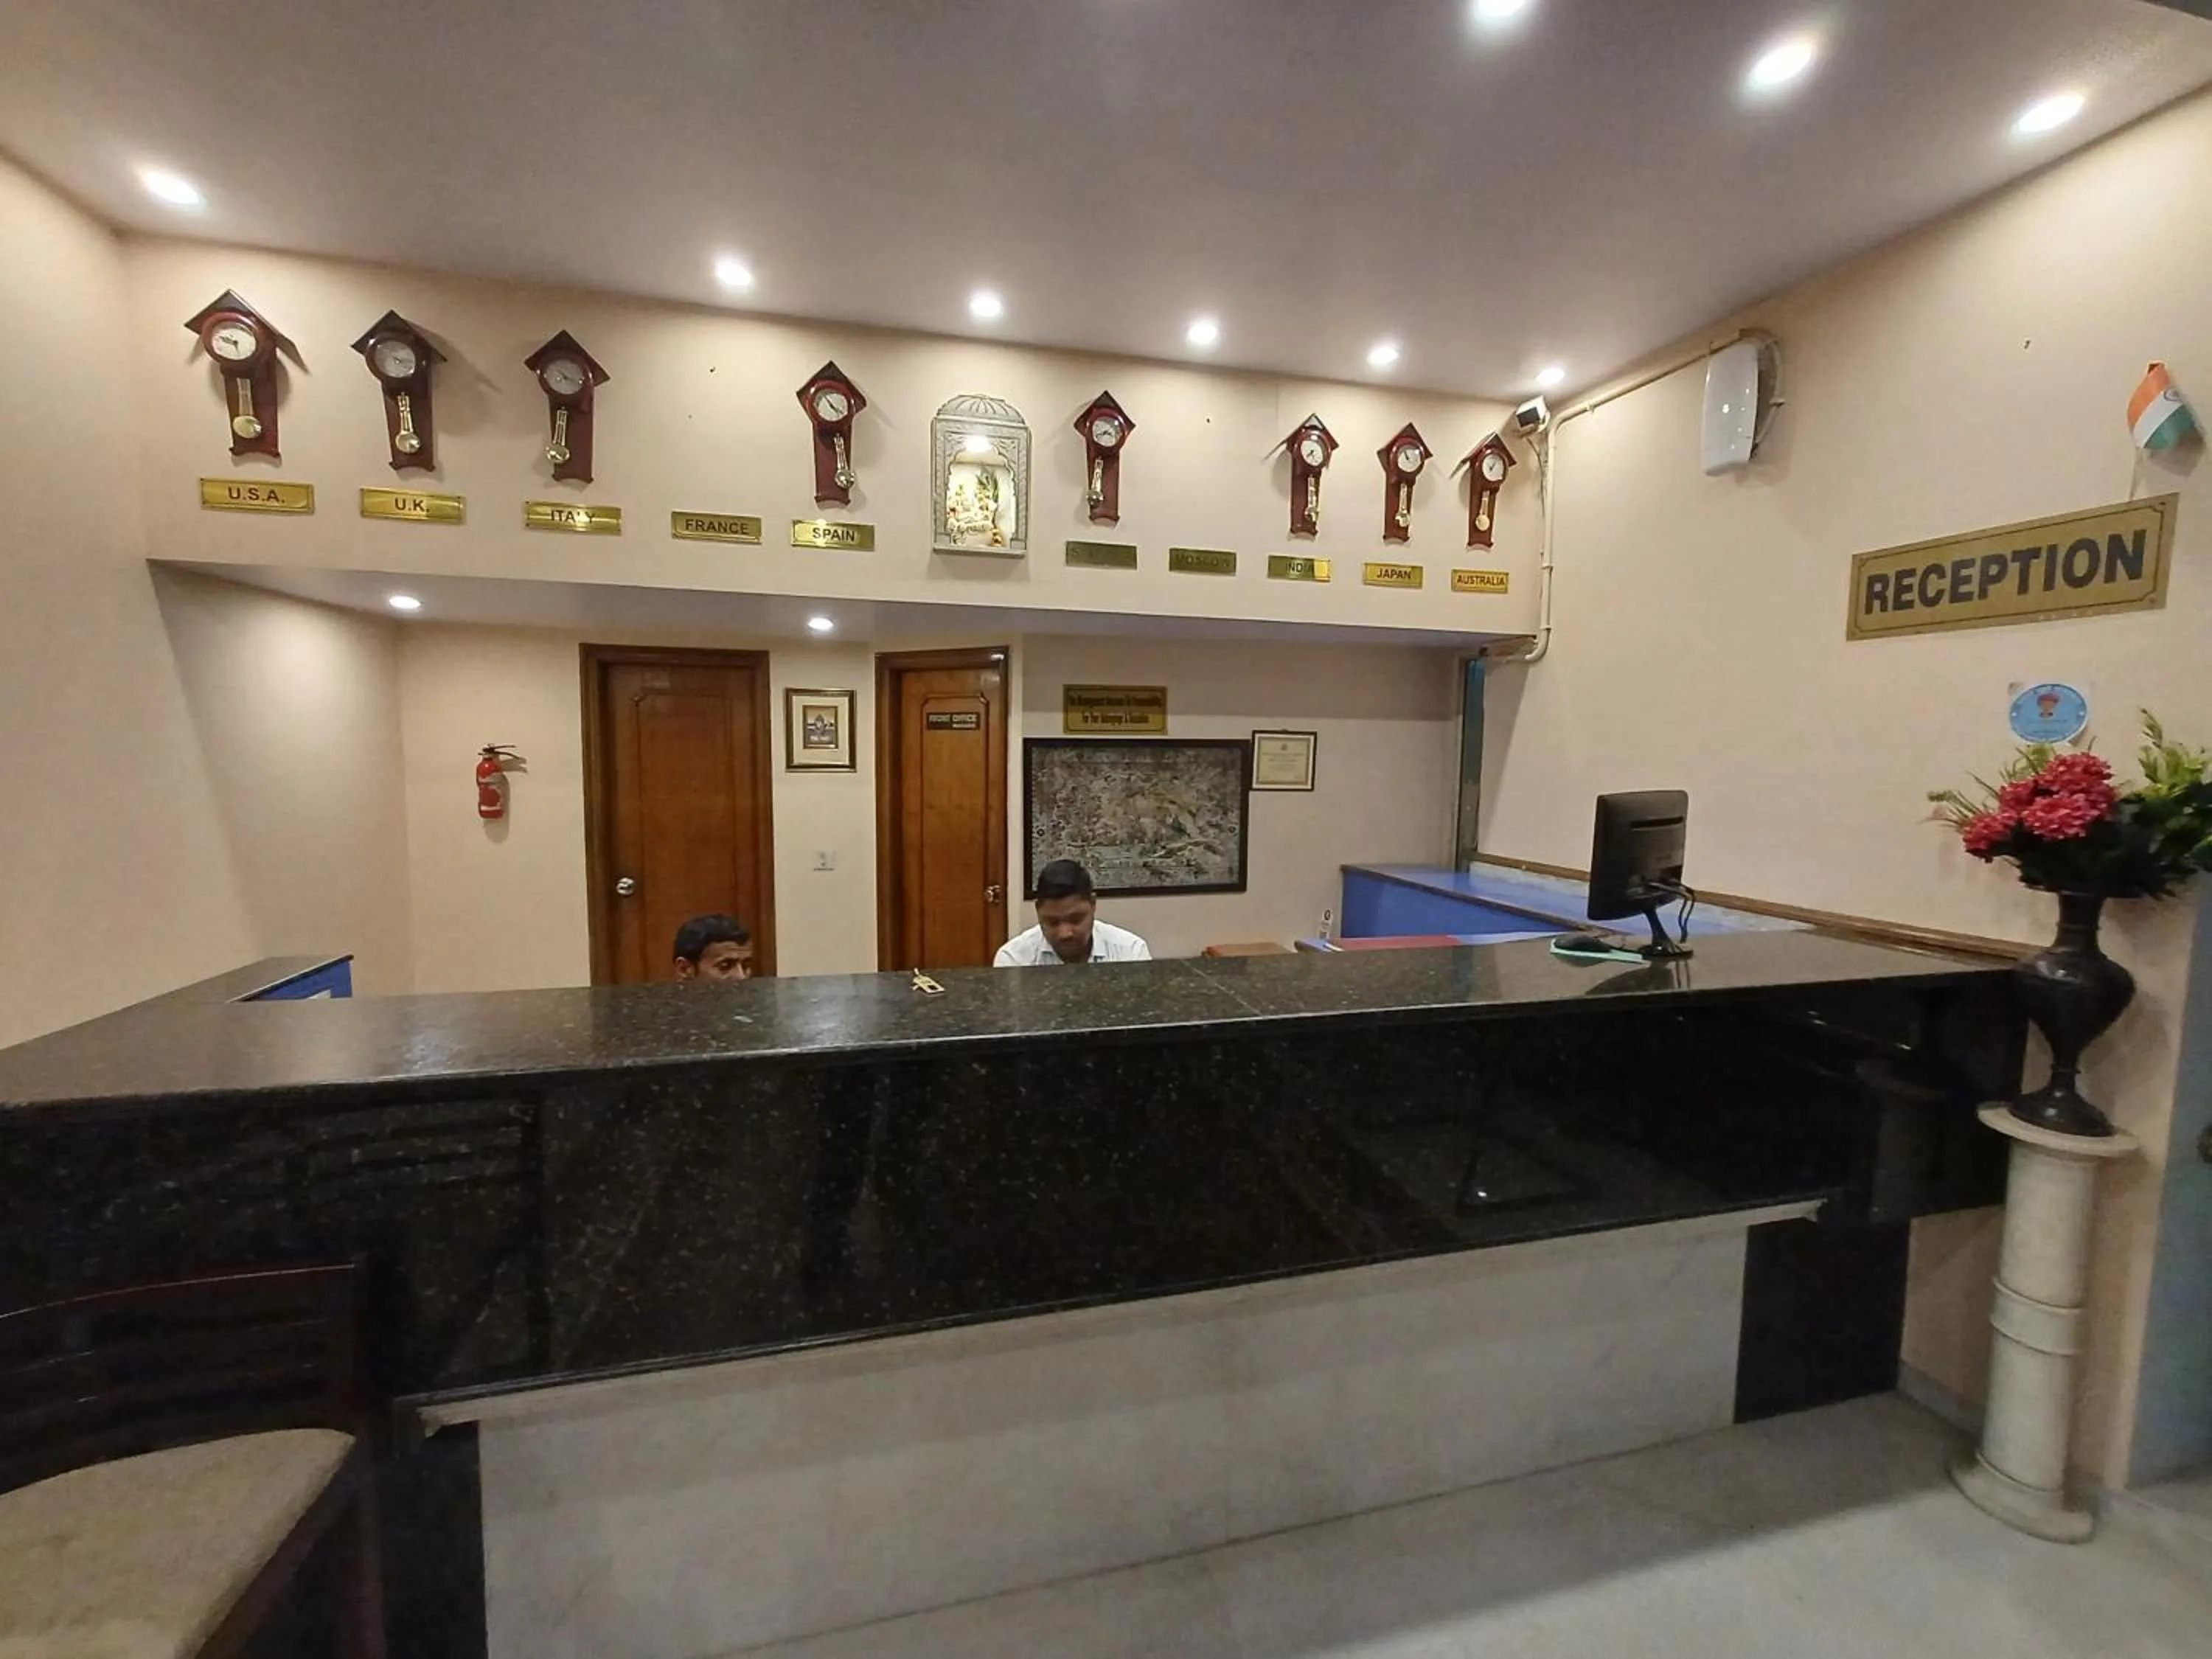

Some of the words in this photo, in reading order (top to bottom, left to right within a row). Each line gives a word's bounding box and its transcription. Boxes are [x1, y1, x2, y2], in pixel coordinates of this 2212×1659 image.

[228, 487, 285, 504] U.S.A.
[394, 498, 430, 512] U.K.
[685, 518, 749, 535] FRANCE
[813, 527, 855, 541] SPAIN
[1377, 568, 1411, 580] JAPAN
[1864, 529, 2147, 616] RECEPTION
[1457, 575, 1505, 585] AUSTRALIA
